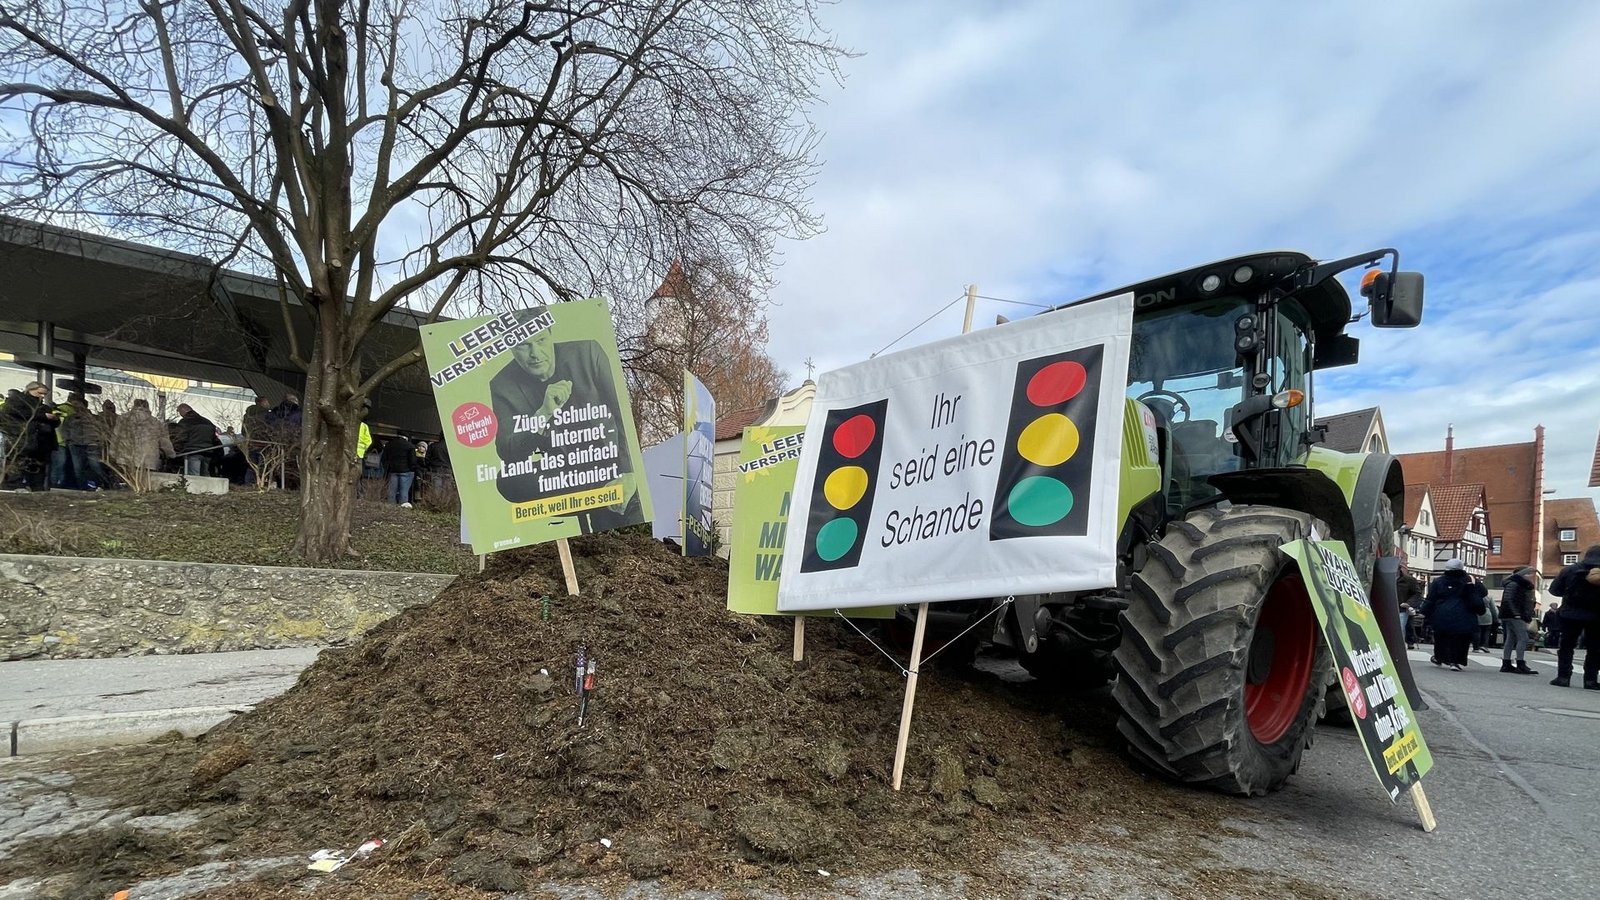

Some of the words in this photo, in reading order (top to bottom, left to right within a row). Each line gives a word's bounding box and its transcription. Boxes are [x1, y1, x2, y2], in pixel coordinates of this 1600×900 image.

[1136, 287, 1176, 307] ON
[430, 312, 555, 387] VERSPRECHEN!
[449, 313, 517, 357] LEERE
[457, 414, 493, 435] Briefwahl
[513, 414, 551, 434] Züge,
[553, 402, 612, 426] Schulen,
[931, 392, 962, 430] Ihr
[468, 427, 489, 444] jetzt!
[551, 423, 606, 448] Internet
[476, 463, 498, 482] Ein
[501, 455, 538, 479] Land,
[540, 452, 565, 472] das
[568, 441, 618, 465] einfach
[890, 443, 939, 490] seid
[943, 434, 995, 476] eine
[538, 463, 623, 493] funktioniert.
[515, 503, 547, 519] Bereit,
[547, 498, 568, 513] weil
[570, 496, 582, 509] Ihr
[584, 494, 595, 506] es
[597, 490, 621, 505] seid.
[881, 491, 984, 548] Schande
